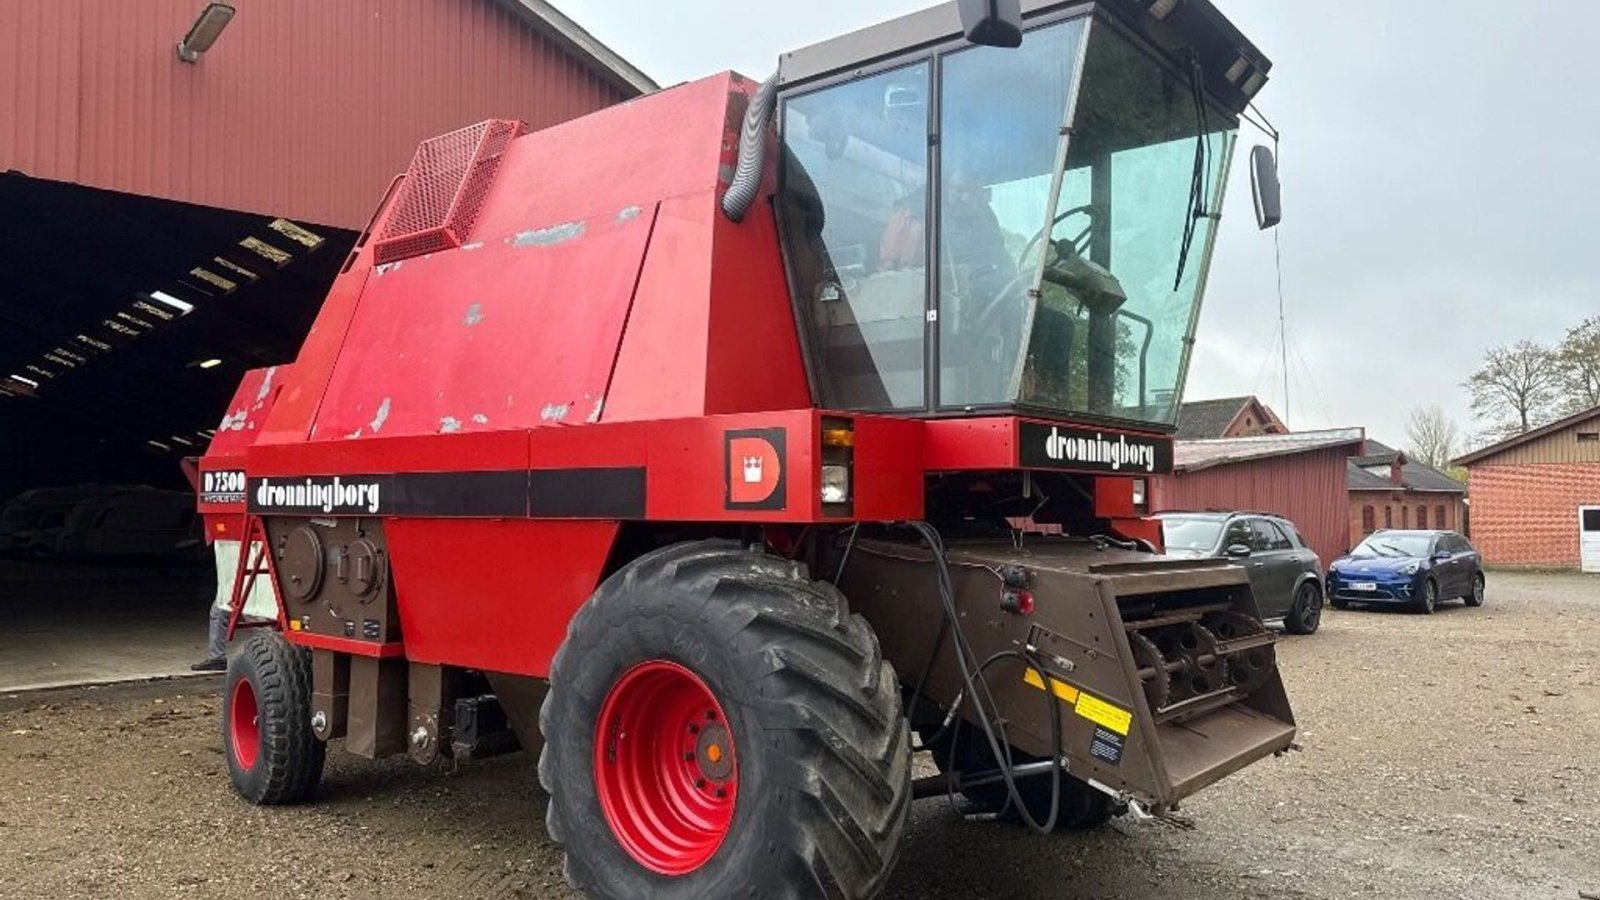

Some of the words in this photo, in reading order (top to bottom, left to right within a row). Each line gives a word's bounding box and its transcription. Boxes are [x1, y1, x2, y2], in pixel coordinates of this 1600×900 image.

[1045, 426, 1154, 472] dronningborg
[215, 471, 246, 492] 7500
[257, 476, 380, 513] dronningborg
